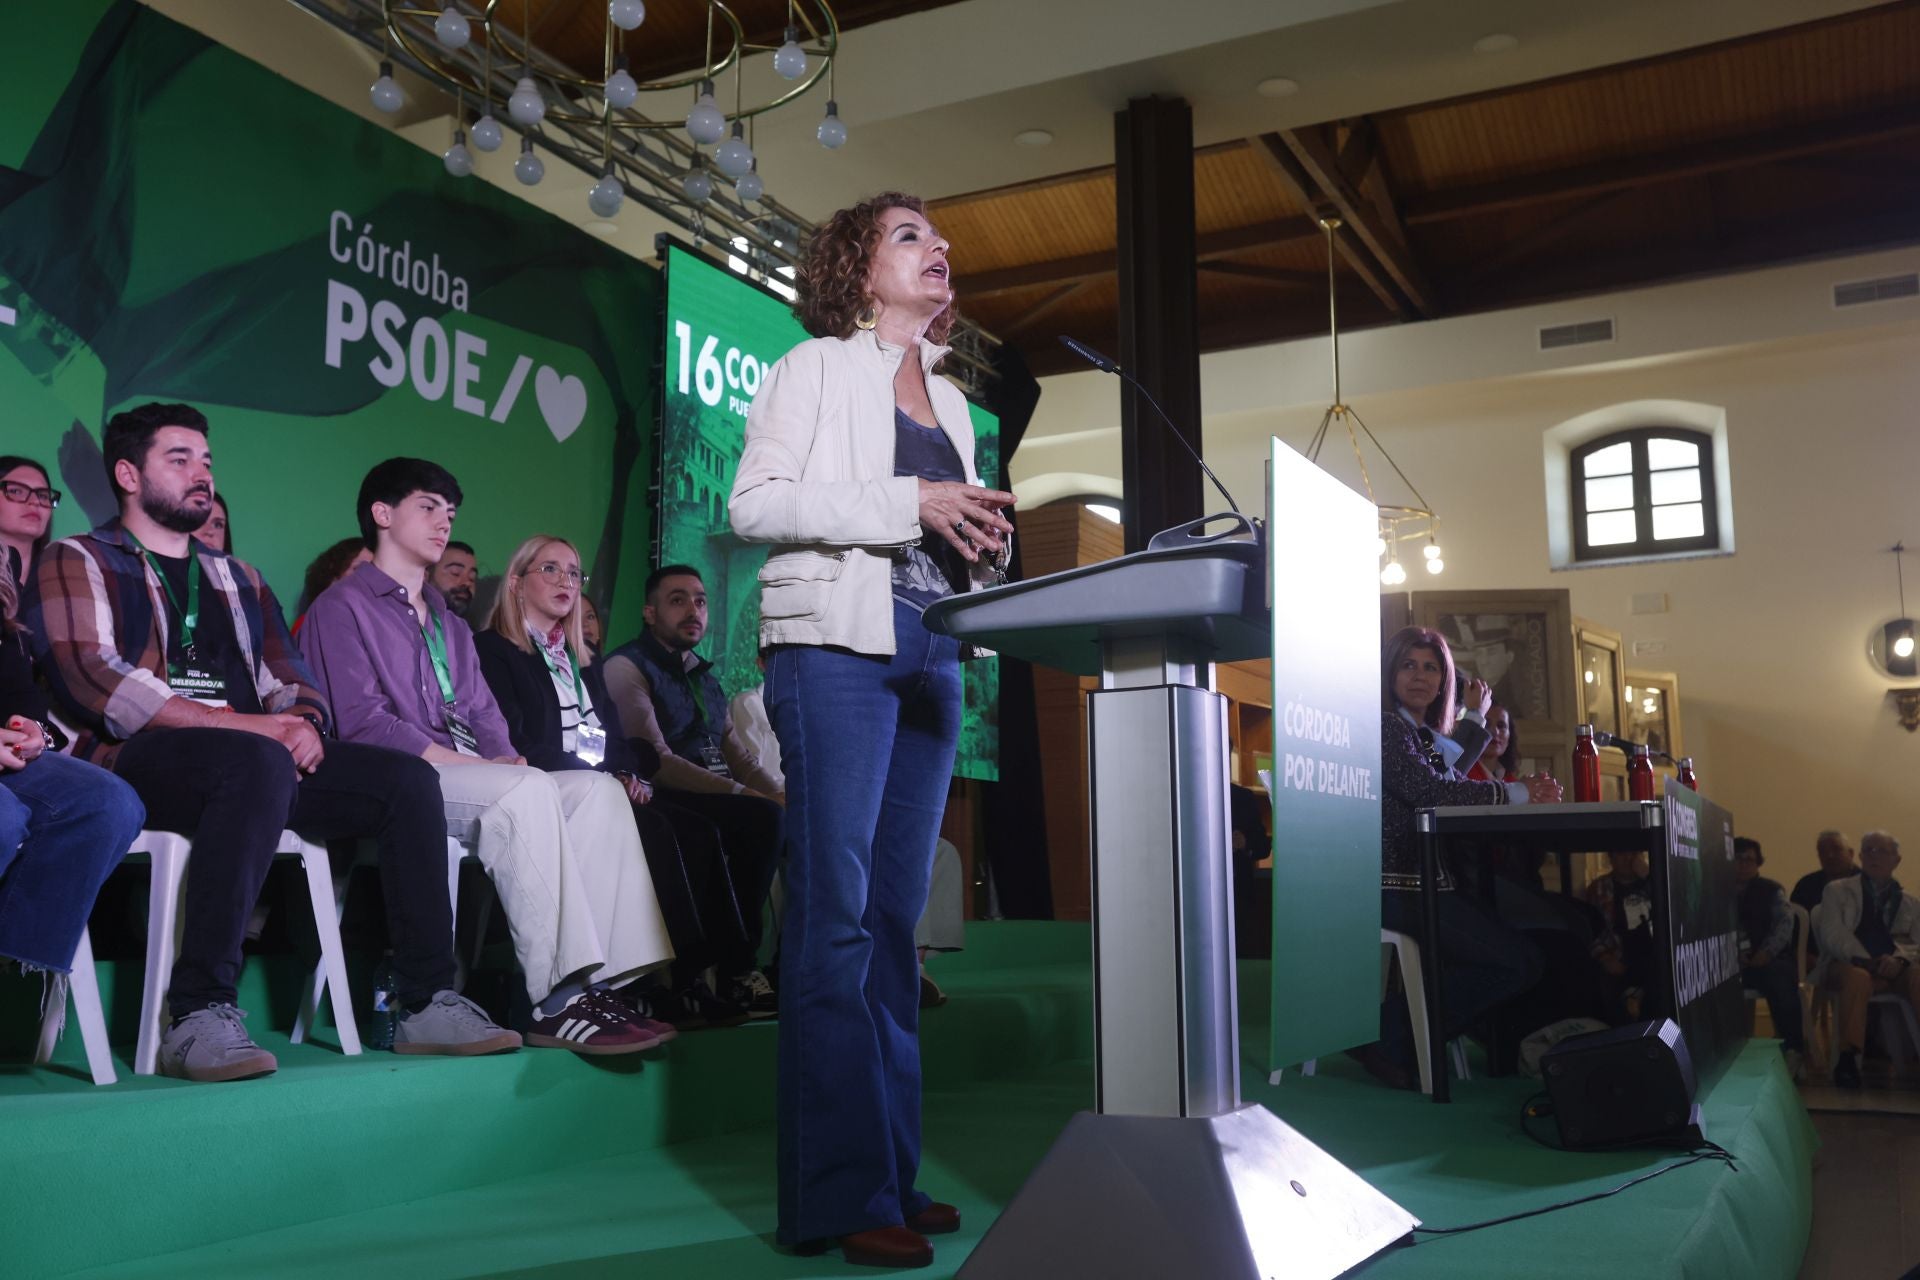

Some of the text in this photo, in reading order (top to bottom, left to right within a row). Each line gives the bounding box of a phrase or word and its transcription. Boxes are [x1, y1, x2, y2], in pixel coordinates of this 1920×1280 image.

[329, 210, 469, 313] Córdoba
[675, 319, 723, 407] 16
[171, 678, 223, 688] DELEGADO/A
[1528, 619, 1545, 716] MACHADO
[1284, 693, 1350, 748] CÓRDOBA
[1284, 754, 1314, 791] POR
